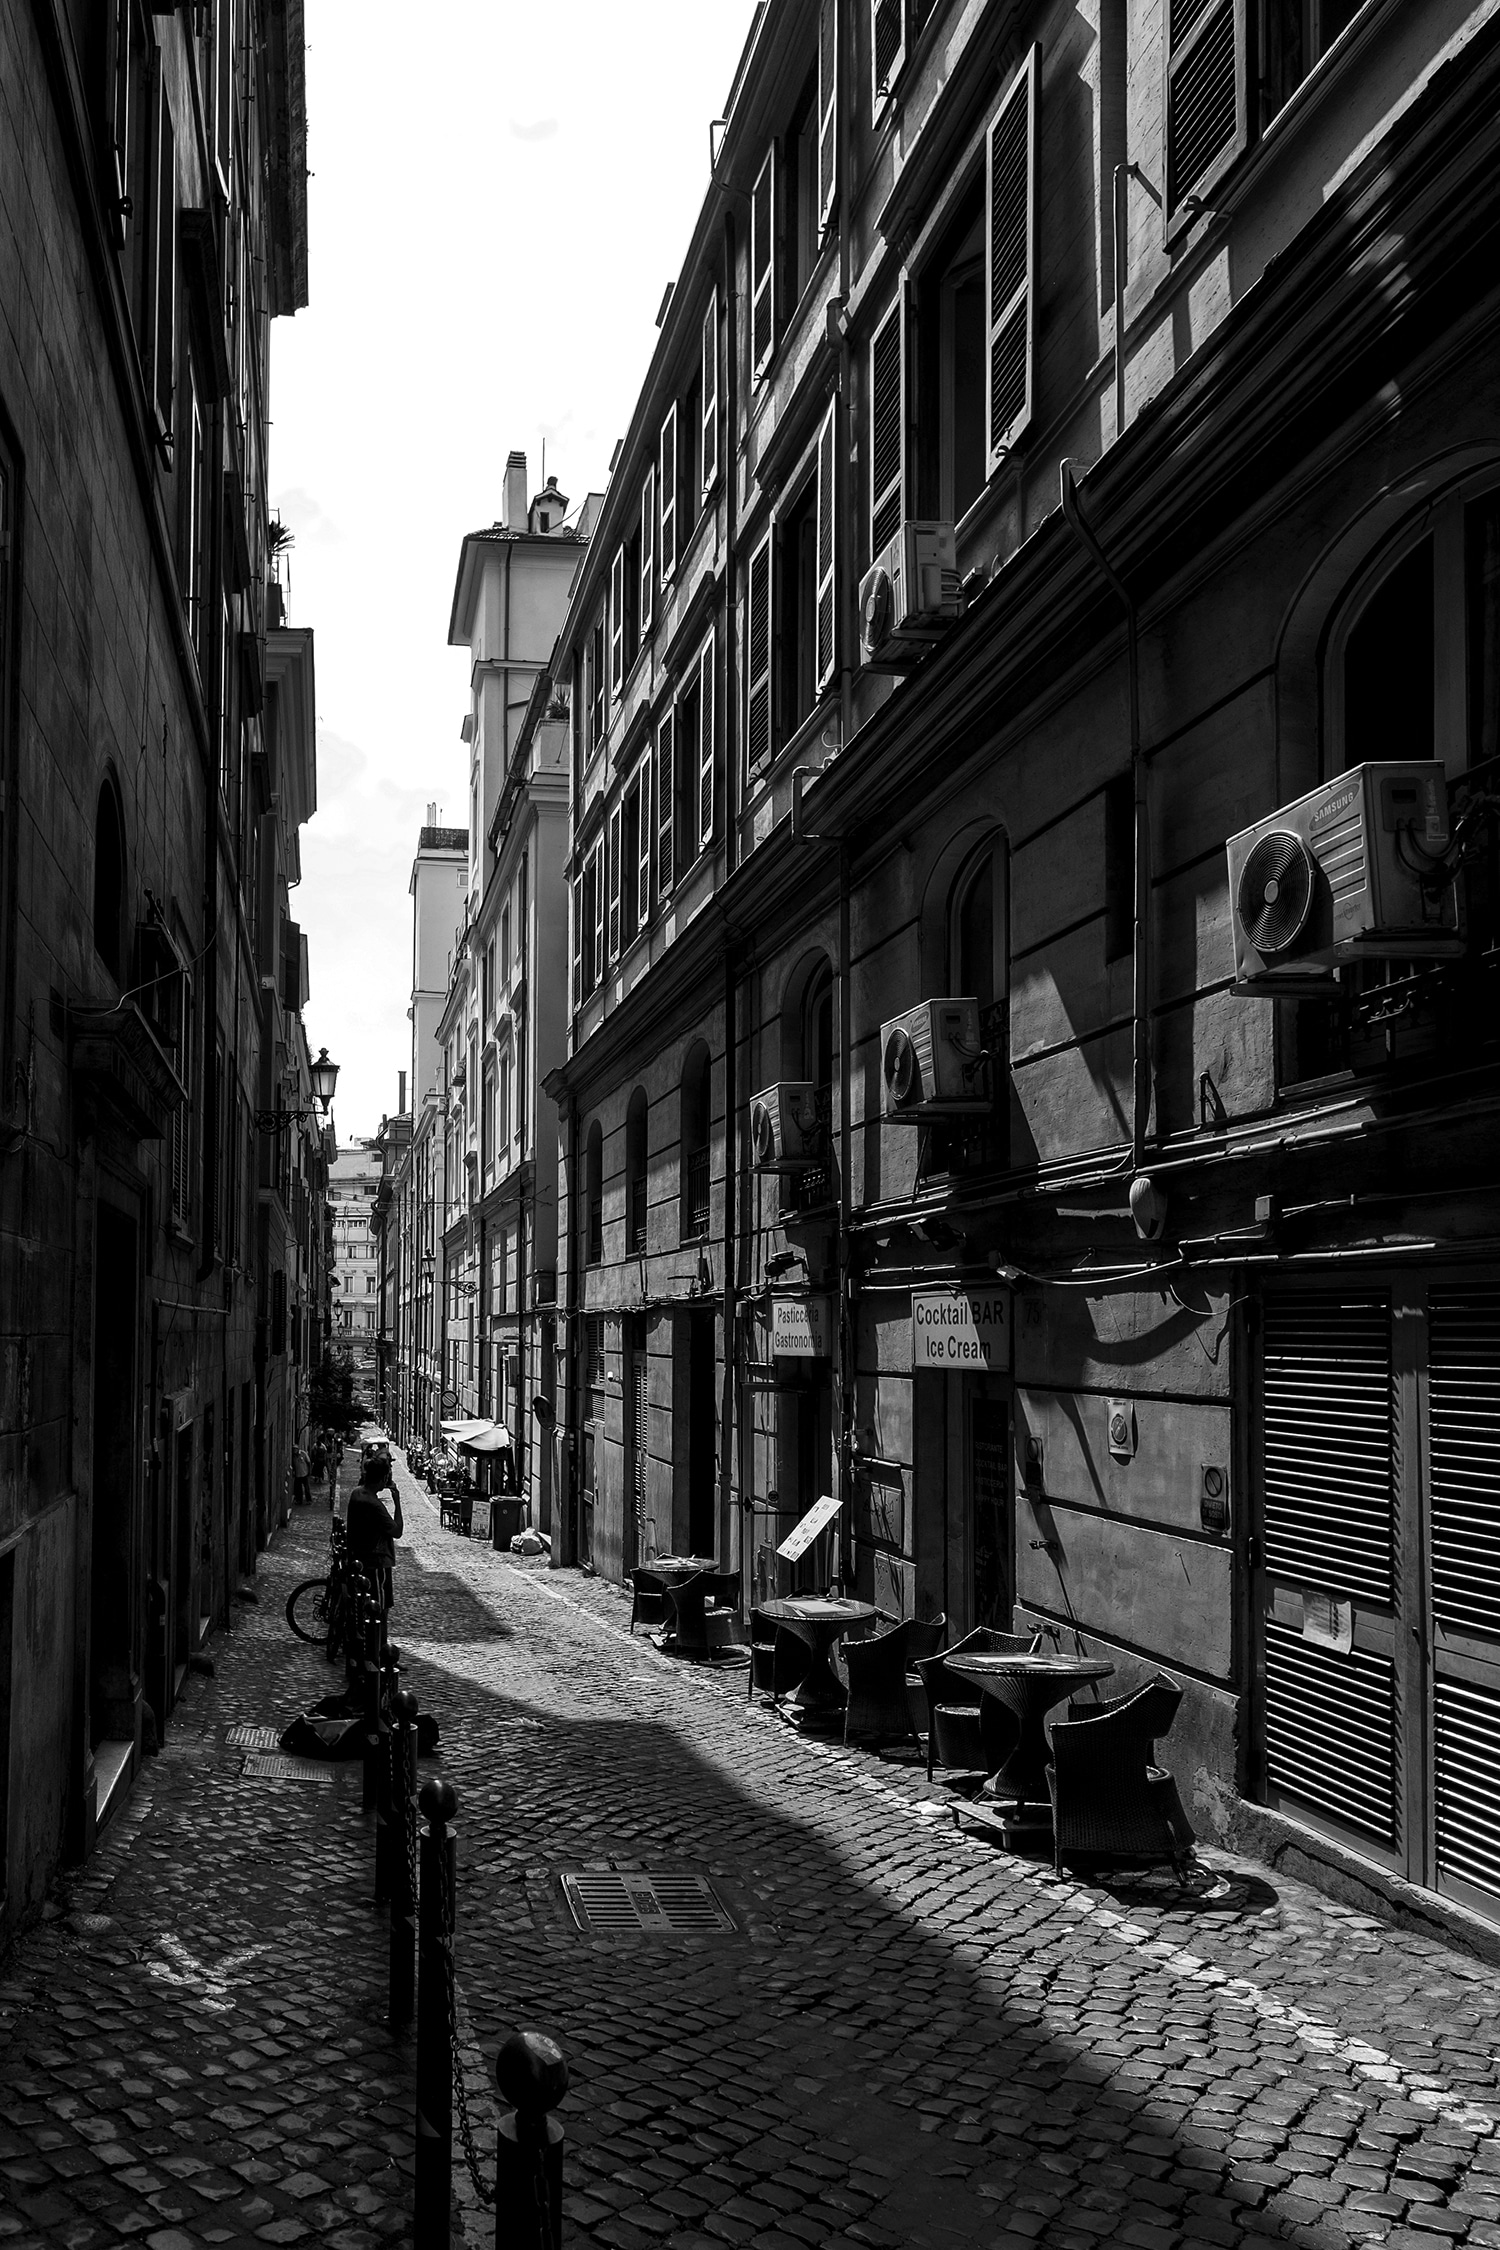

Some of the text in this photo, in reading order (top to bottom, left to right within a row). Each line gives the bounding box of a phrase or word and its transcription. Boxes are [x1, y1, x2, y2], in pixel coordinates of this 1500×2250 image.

[1314, 792, 1354, 822] SAMSUNG
[777, 1305, 819, 1324] Pasticceria
[916, 1300, 1004, 1325] Cocktail BAR
[1026, 1302, 1040, 1324] 75
[775, 1331, 822, 1349] Gastronomia
[926, 1335, 991, 1360] Ice Cream
